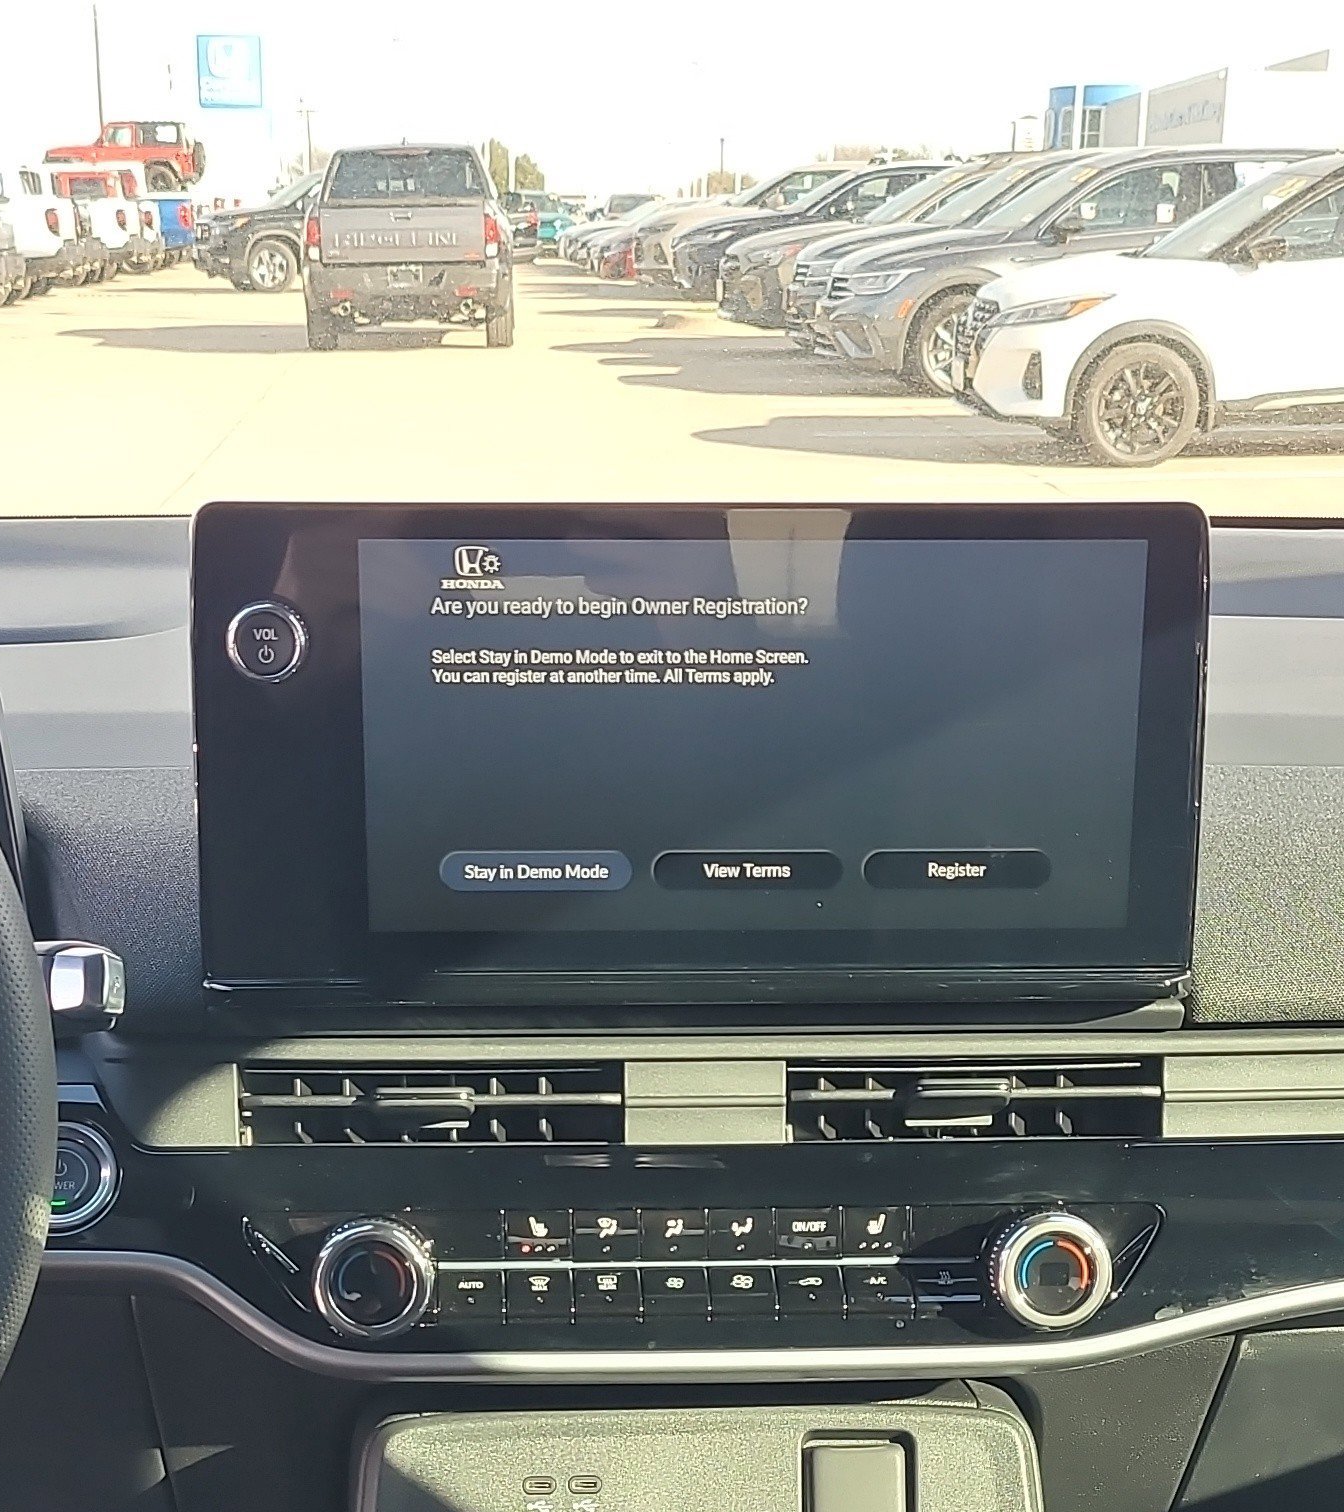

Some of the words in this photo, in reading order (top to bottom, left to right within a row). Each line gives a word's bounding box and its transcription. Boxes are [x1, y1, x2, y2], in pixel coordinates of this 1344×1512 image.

[441, 579, 505, 590] HONDA
[430, 597, 463, 615] Are
[465, 600, 498, 618] you
[503, 597, 552, 619] ready
[556, 598, 574, 615] to
[578, 597, 627, 619] begin
[631, 598, 688, 615] Owner
[693, 597, 808, 619] Registration?
[253, 628, 279, 641] VOL
[431, 649, 477, 664] Select
[479, 650, 512, 667] Stay
[514, 649, 527, 664] in
[530, 650, 573, 664] Demo
[576, 650, 617, 664] Mode
[619, 651, 634, 664] to
[637, 649, 664, 664] exit
[666, 651, 682, 664] to
[684, 649, 707, 664] the
[709, 650, 753, 664] Home
[755, 649, 809, 664] Screen.
[432, 669, 460, 683] You
[463, 672, 490, 683] can
[492, 670, 547, 687] register
[549, 671, 564, 683] at
[567, 669, 622, 683] another
[624, 669, 661, 684] time.
[663, 668, 682, 683] All
[685, 669, 730, 683] Terms
[733, 668, 775, 687] apply.
[464, 864, 498, 882] Stay
[499, 864, 513, 879] in
[517, 864, 562, 880] Demo
[565, 864, 609, 880] Mode
[703, 863, 741, 878] View
[743, 863, 791, 878] Terms
[928, 862, 986, 880] Register
[54, 1181, 76, 1190] WER
[792, 1221, 827, 1233] ON/OFF
[458, 1281, 485, 1290] AUTO
[869, 1276, 888, 1285] A/C
